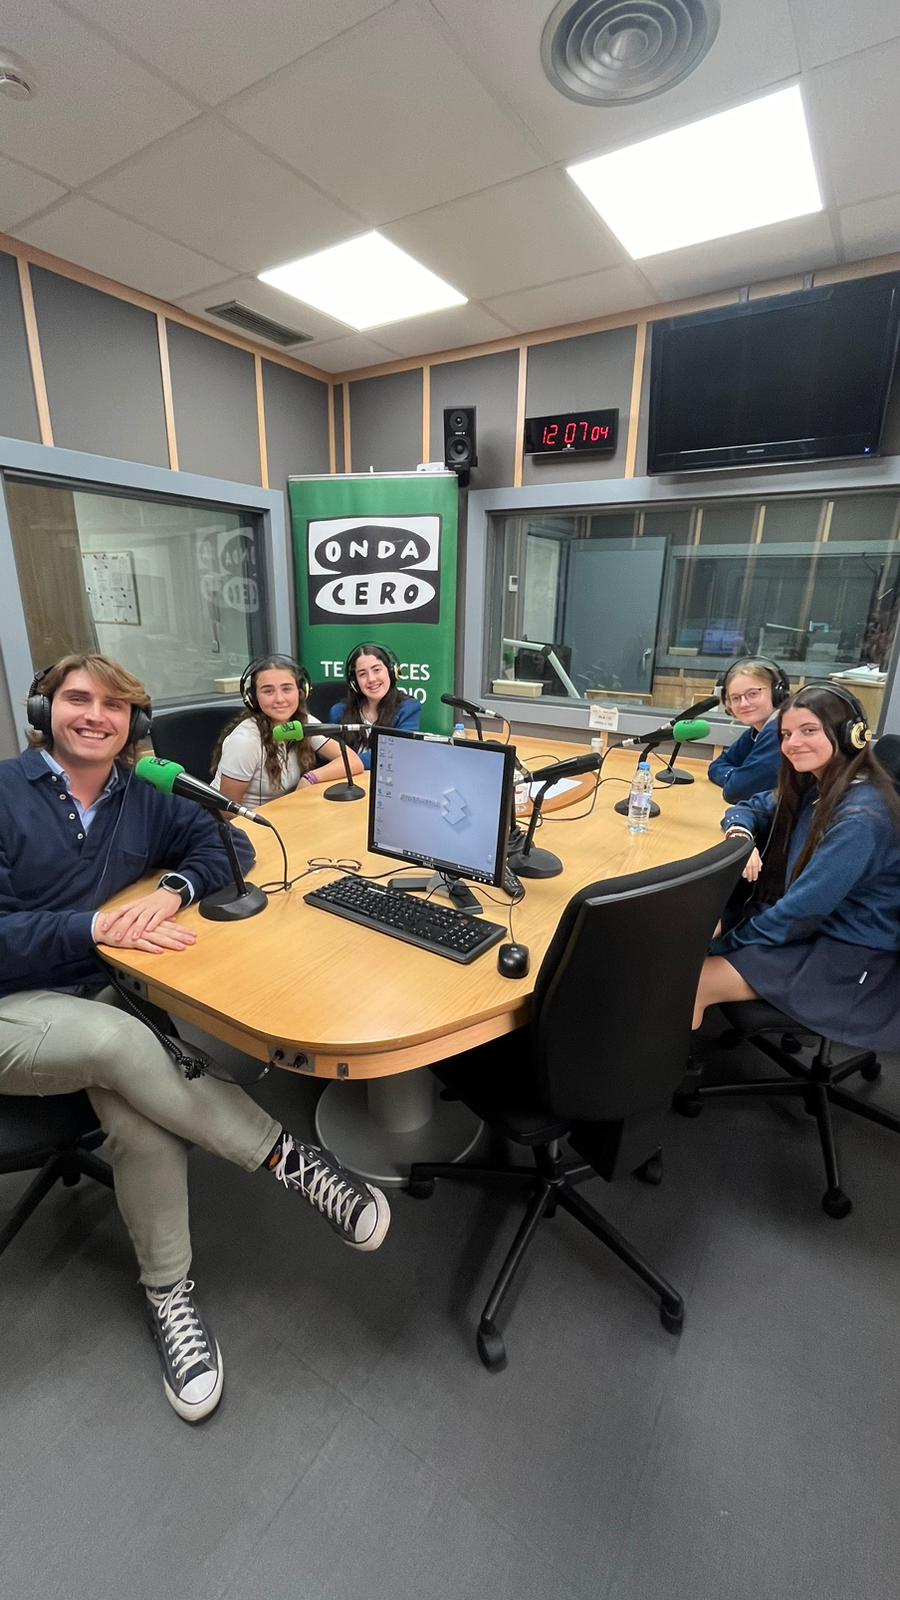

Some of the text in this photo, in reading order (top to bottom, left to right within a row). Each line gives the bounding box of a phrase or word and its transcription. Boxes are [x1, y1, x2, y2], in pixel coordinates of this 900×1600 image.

[542, 421, 609, 445] 12 07 04
[325, 539, 419, 563] ONDA
[332, 581, 419, 606] CERO
[320, 660, 344, 677] TE
